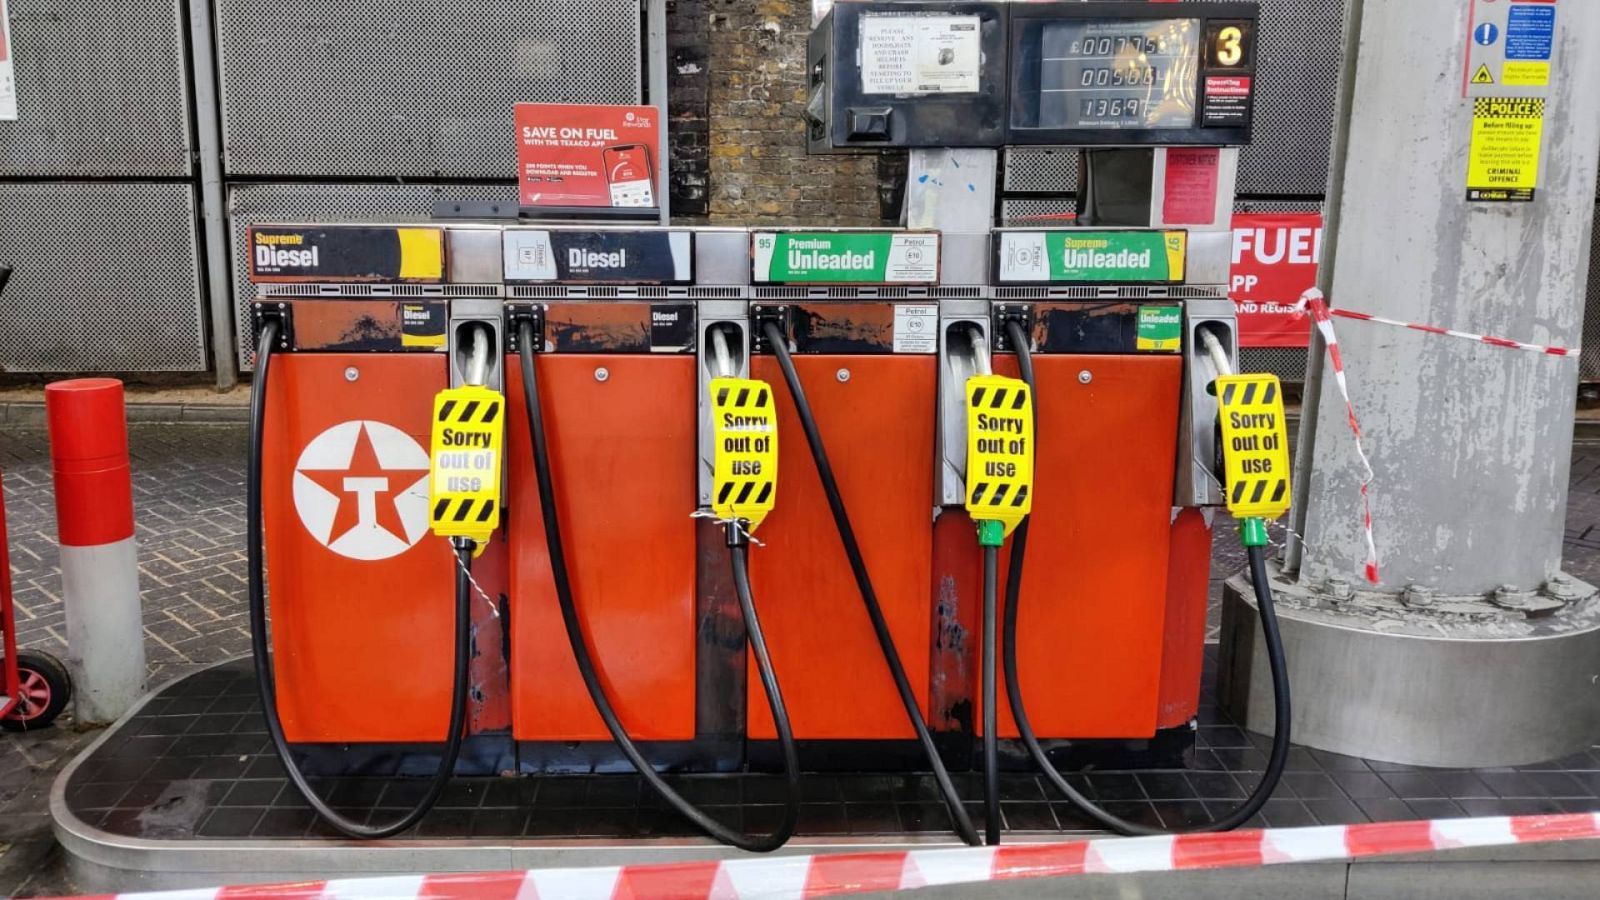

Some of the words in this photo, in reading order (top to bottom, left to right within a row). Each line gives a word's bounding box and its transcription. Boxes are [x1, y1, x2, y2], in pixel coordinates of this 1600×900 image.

[1217, 27, 1242, 66] 3
[1490, 104, 1532, 115] POLICE
[523, 127, 556, 138] SAVE
[560, 127, 582, 139] ON
[586, 128, 618, 140] FUEL
[256, 233, 302, 245] Supreme
[759, 239, 771, 249] 95
[788, 238, 831, 249] Premium
[1065, 237, 1108, 248] Supreme
[256, 246, 319, 266] Diesel
[568, 249, 626, 267] Diesel
[788, 250, 874, 270] Unleaded
[1064, 249, 1150, 268] Unleaded
[1228, 275, 1258, 292] PP
[404, 310, 430, 320] Diesel
[652, 312, 678, 321] Diesel
[906, 307, 926, 315] Petrol
[1141, 314, 1179, 323] Unleaded
[724, 413, 767, 432] Sorry
[978, 413, 1023, 434] Sorry
[1230, 412, 1275, 429] Sorry
[442, 428, 492, 448] Sorry
[724, 437, 750, 453] out
[754, 436, 770, 453] of
[1232, 435, 1259, 451] out
[1263, 432, 1279, 450] of
[978, 438, 1005, 454] out
[1009, 438, 1025, 455] of
[440, 453, 469, 470] out
[474, 452, 493, 470] of
[732, 460, 761, 476] use
[1242, 458, 1271, 474] use
[986, 462, 1016, 477] use
[448, 477, 482, 492] use
